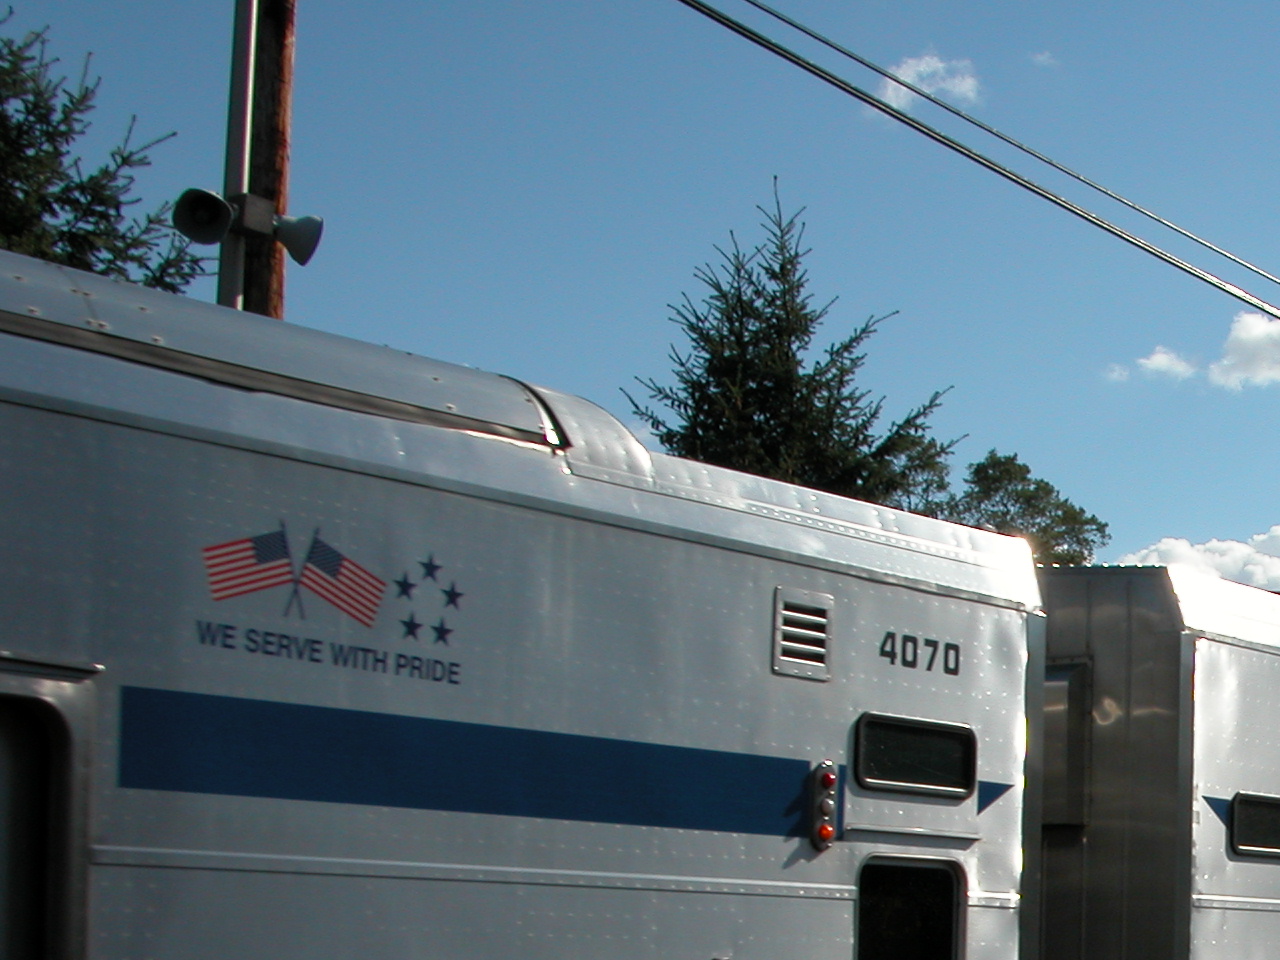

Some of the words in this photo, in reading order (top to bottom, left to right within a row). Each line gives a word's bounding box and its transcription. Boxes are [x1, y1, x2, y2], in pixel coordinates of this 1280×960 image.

[197, 619, 237, 650] WE
[243, 628, 323, 663] SERVE
[331, 641, 387, 675] WITH
[394, 654, 461, 686] PRIDE
[879, 632, 960, 676] 4070
